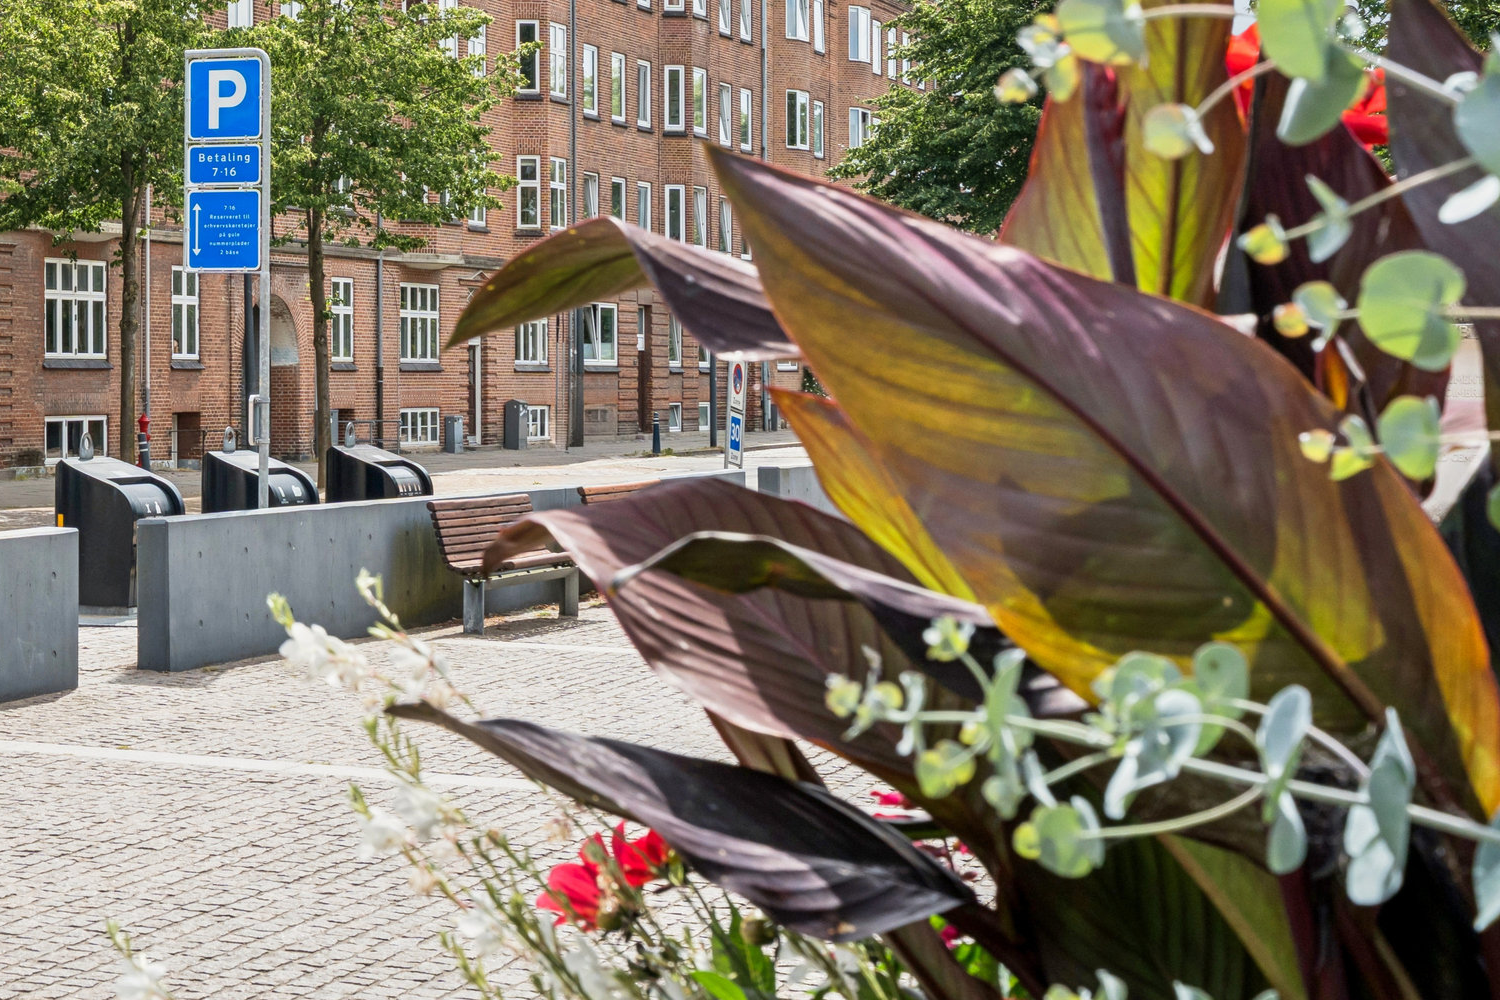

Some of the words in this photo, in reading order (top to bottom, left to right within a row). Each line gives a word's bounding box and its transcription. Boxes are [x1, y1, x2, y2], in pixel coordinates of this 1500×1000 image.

[208, 69, 247, 130] P
[198, 153, 250, 163] Betaling
[731, 423, 740, 442] 30
